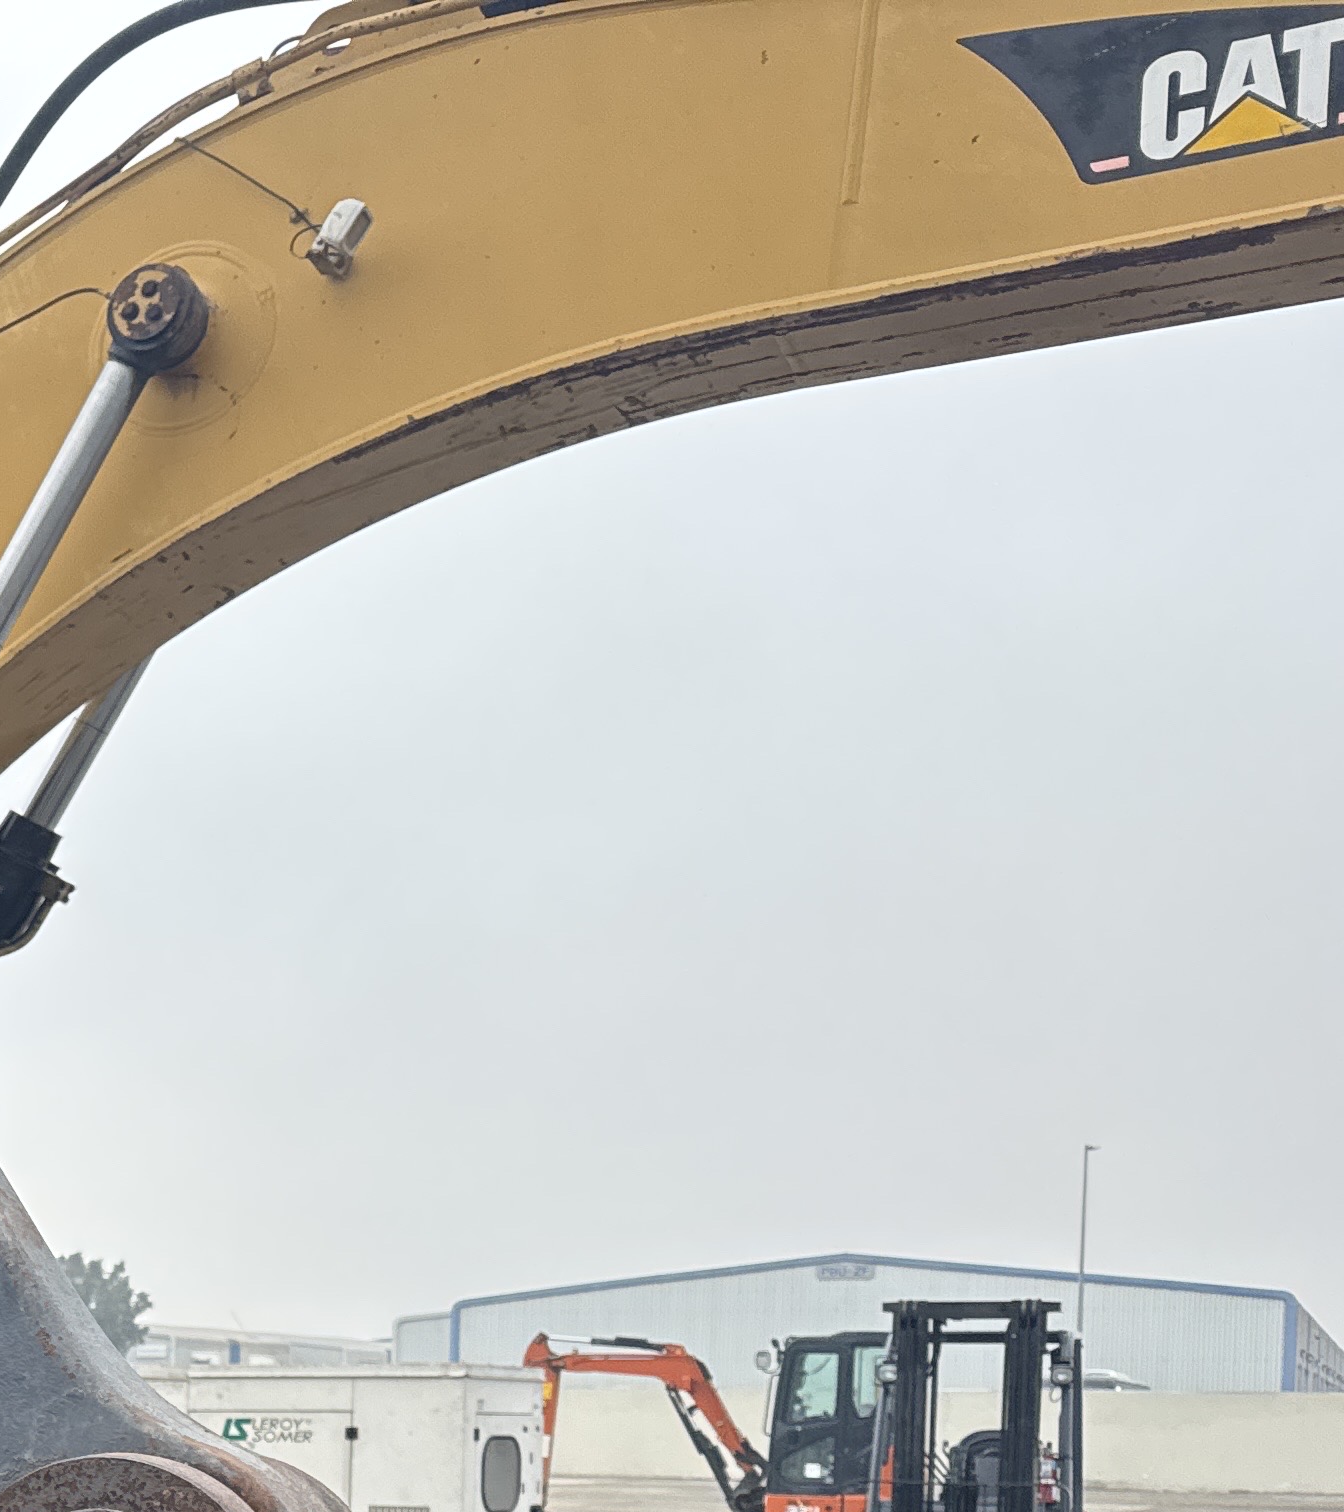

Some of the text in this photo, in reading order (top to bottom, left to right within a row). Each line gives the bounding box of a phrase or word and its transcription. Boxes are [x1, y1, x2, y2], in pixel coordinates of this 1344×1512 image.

[1140, 18, 1344, 160] CAT
[252, 1417, 303, 1431] LEROY
[252, 1429, 313, 1443] SOMER
